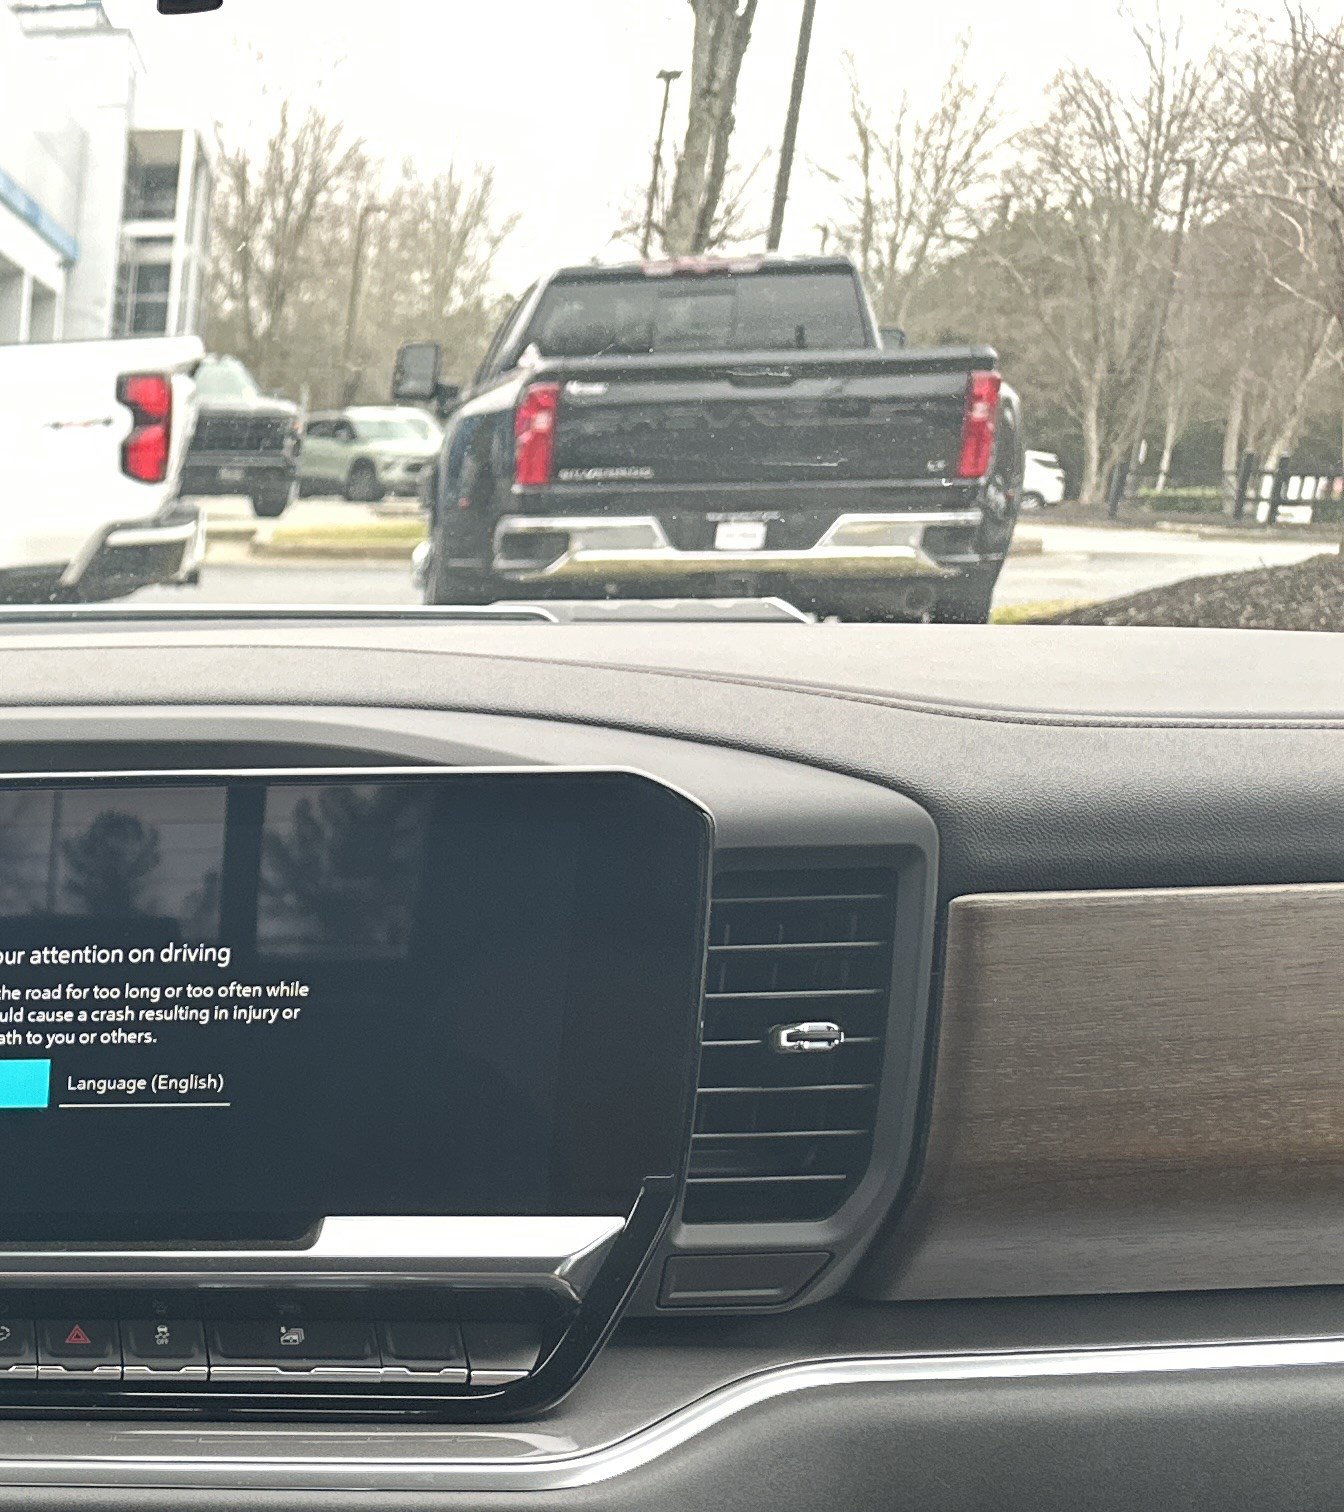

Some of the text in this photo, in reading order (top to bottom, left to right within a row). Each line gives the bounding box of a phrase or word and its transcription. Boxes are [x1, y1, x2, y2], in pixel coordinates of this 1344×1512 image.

[29, 944, 124, 965] attention
[128, 947, 155, 964] on
[159, 941, 231, 968] driving
[25, 983, 62, 1001] road
[65, 982, 90, 1000] for
[92, 984, 121, 1000] too
[124, 982, 161, 1003] long
[164, 986, 184, 999] or
[185, 983, 215, 998] too
[217, 980, 263, 998] often
[265, 980, 310, 998] while
[27, 1010, 75, 1023] cause
[77, 1010, 88, 1022] a
[90, 1005, 136, 1022] crash
[138, 1004, 210, 1025] resulting
[213, 1005, 229, 1021] in
[232, 1004, 280, 1025] injury
[281, 1007, 301, 1020] or
[25, 1030, 44, 1045] to
[44, 1032, 76, 1049] you
[78, 1032, 98, 1045] or
[99, 1027, 158, 1044] others.
[67, 1073, 224, 1095] Language (English)
